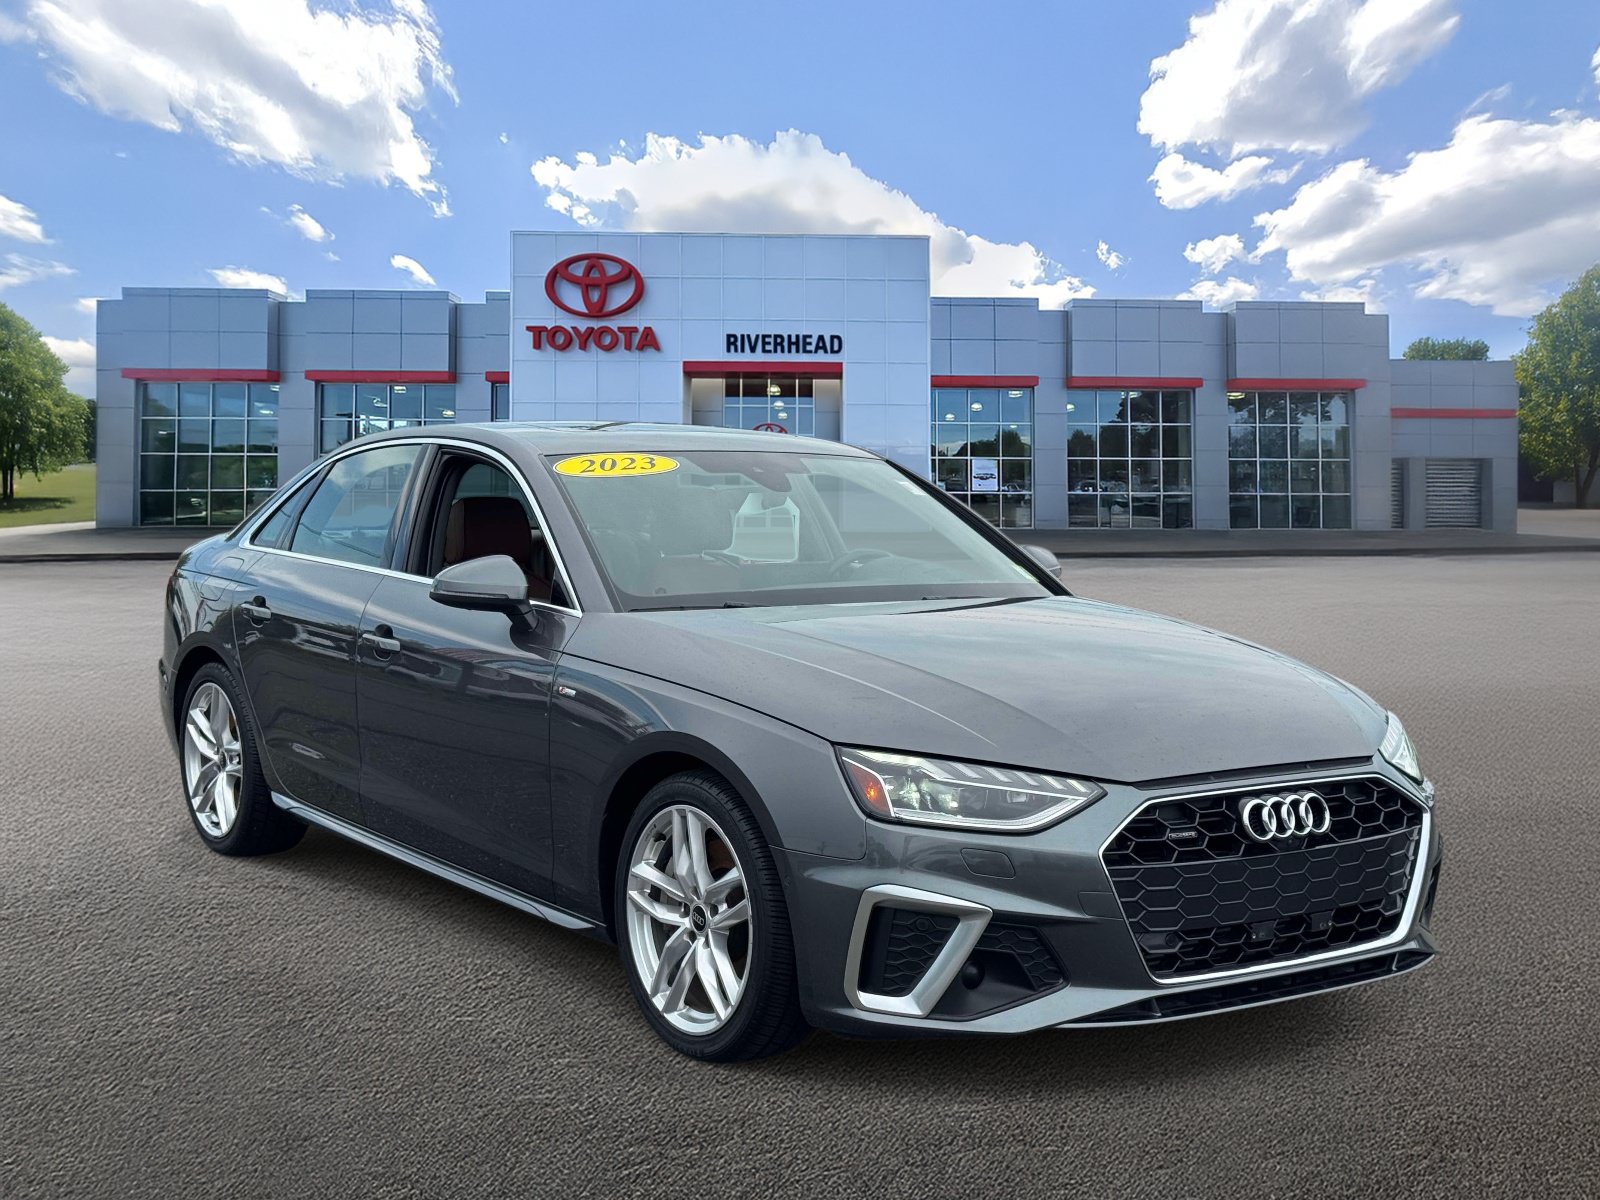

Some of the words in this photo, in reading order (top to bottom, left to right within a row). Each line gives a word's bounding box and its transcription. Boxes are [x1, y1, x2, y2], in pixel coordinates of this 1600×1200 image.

[526, 325, 661, 351] TOYOTA
[726, 333, 843, 354] RIVERHEAD
[580, 457, 656, 473] 2023
